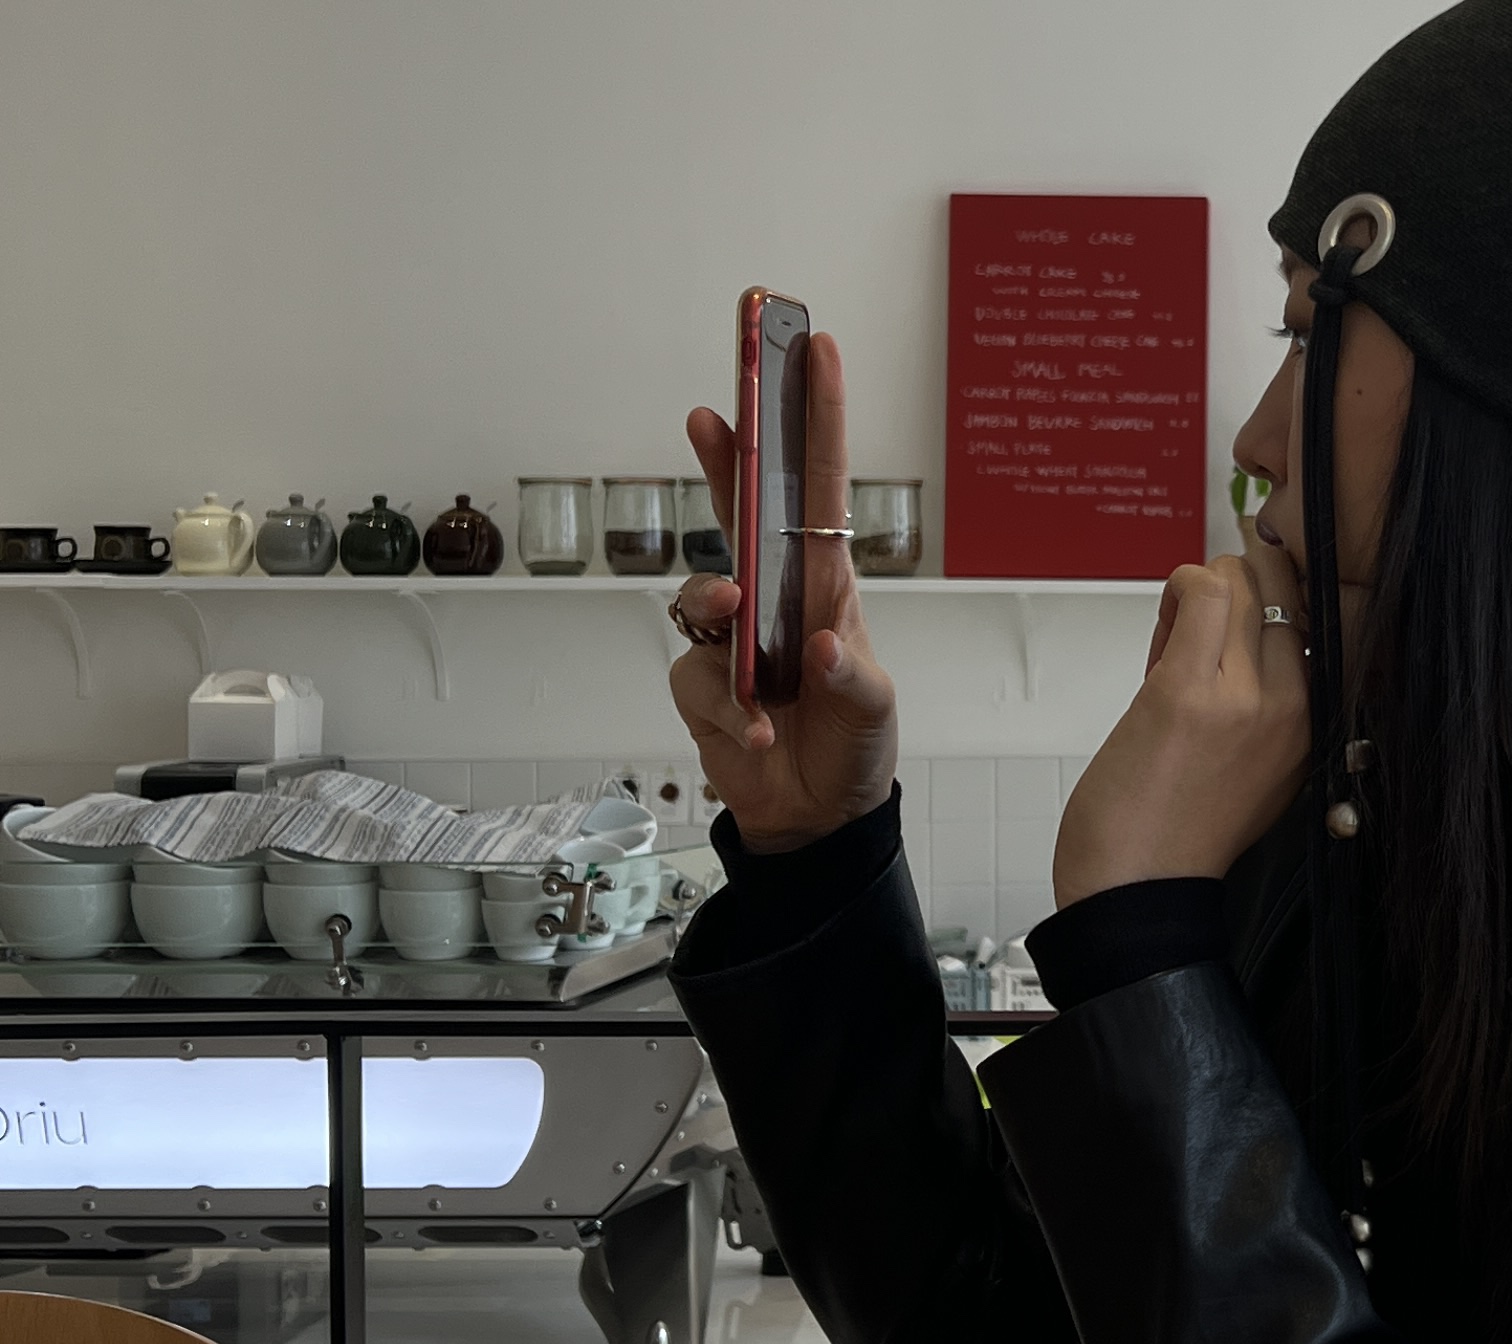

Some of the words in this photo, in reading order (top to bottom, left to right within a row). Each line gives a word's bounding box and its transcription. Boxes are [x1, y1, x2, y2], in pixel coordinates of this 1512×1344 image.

[1088, 232, 1136, 246] CAKE
[1039, 266, 1077, 280] CAKE
[974, 307, 1027, 322] DOUBLE
[973, 332, 1016, 347] VEGAN
[1023, 332, 1086, 348] BLUEBERRY
[1011, 360, 1066, 380] SMALL
[1077, 361, 1124, 378] MEAL
[963, 413, 1018, 429] JAMBON
[966, 440, 1009, 456] SMALL
[1014, 441, 1052, 456] PLATE
[0, 1101, 88, 1146] riu
